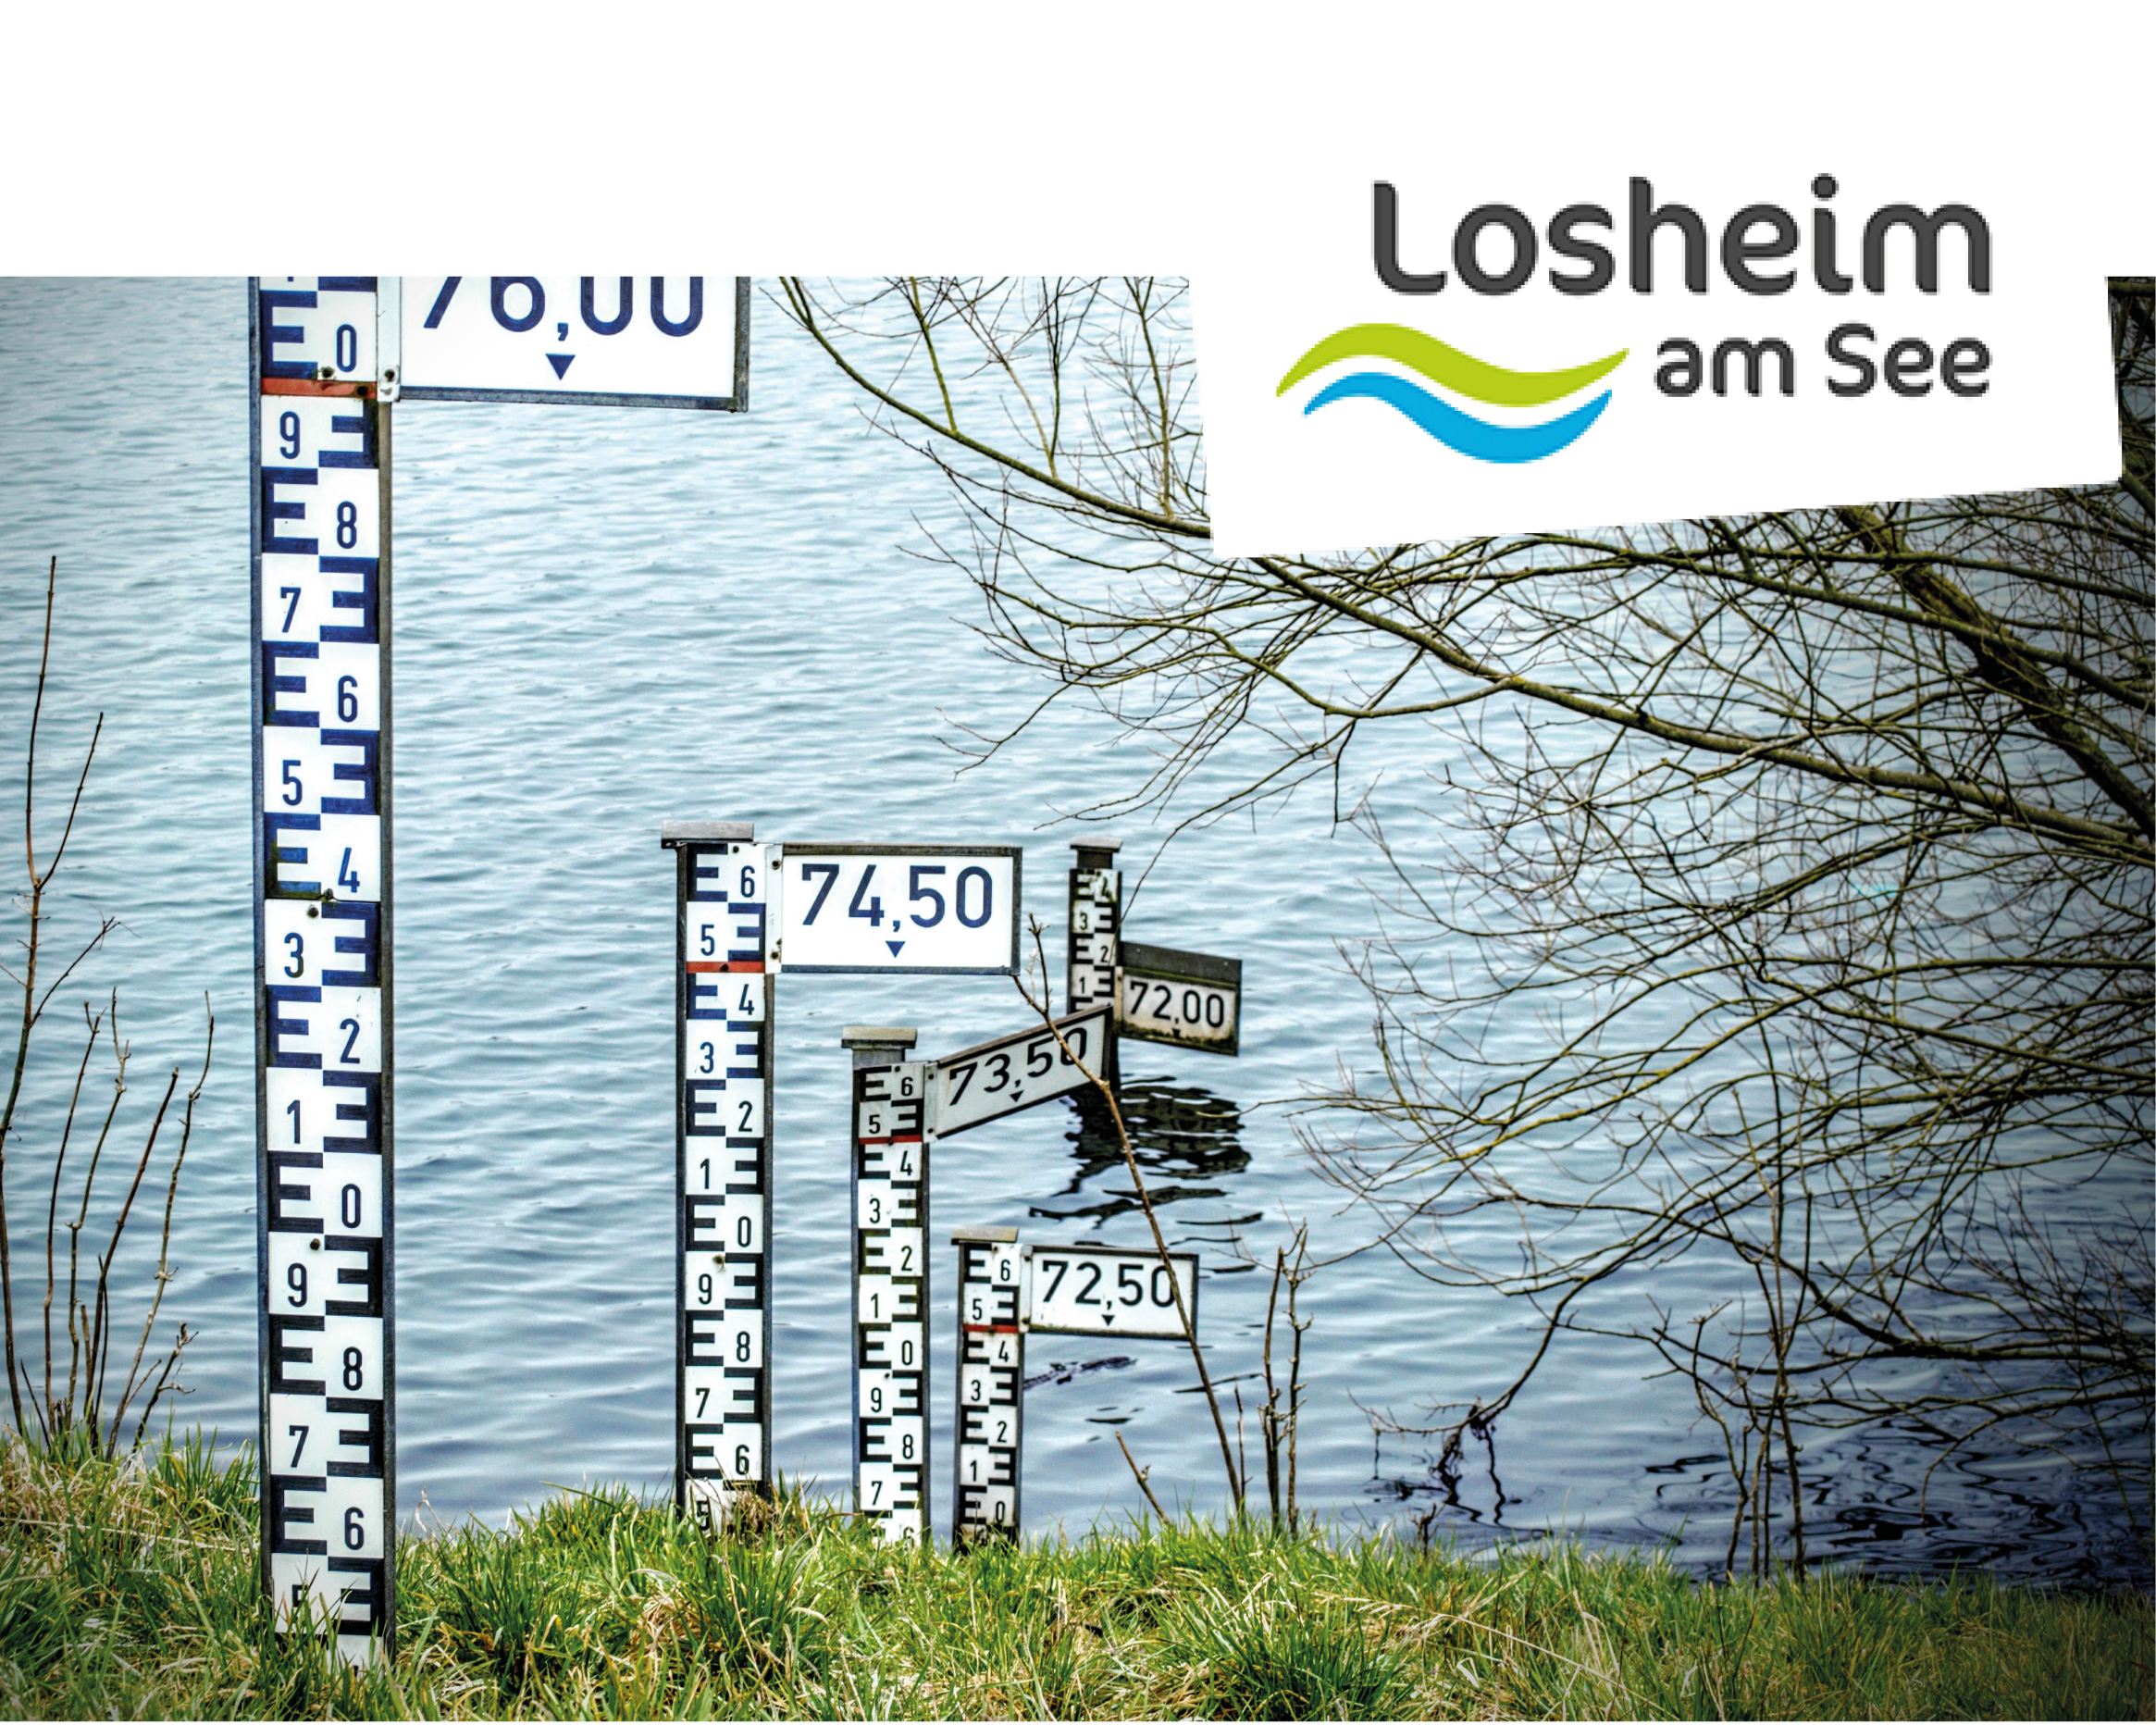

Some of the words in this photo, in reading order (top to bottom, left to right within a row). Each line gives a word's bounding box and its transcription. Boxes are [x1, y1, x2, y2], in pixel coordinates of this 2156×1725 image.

[336, 324, 357, 372] 0
[279, 411, 301, 459] 9
[336, 501, 357, 549] 8
[279, 587, 301, 633] 7
[337, 676, 358, 722] 6
[281, 760, 303, 806] 5
[338, 848, 360, 893] 4
[740, 865, 756, 898] 6
[801, 863, 993, 933] 74,50
[284, 932, 304, 978] 3
[700, 925, 715, 957] 5
[738, 984, 755, 1015] 4
[1130, 980, 1224, 1029] 72,00
[339, 1018, 361, 1064] 2
[700, 1041, 714, 1074] 3
[949, 1027, 1087, 1106] 73,50
[901, 1077, 913, 1097] 6
[287, 1099, 301, 1144] 1
[738, 1100, 753, 1133] 2
[868, 1114, 881, 1134] 5
[700, 1158, 710, 1189] 1
[900, 1150, 913, 1175] 4
[341, 1184, 361, 1229] 0
[869, 1198, 881, 1224] 3
[737, 1216, 751, 1247] 0
[900, 1246, 913, 1272] 2
[288, 1263, 308, 1308] 9
[698, 1273, 712, 1305] 9
[1041, 1260, 1177, 1310] 72,50
[870, 1293, 879, 1319] 1
[736, 1331, 750, 1362] 8
[901, 1340, 913, 1366] 0
[343, 1346, 363, 1391] 8
[695, 1387, 710, 1418] 7
[870, 1387, 883, 1413] 9
[289, 1425, 309, 1468] 7
[735, 1444, 750, 1476] 6
[902, 1434, 914, 1459] 8
[871, 1481, 883, 1506] 7
[344, 1507, 365, 1551] 6
